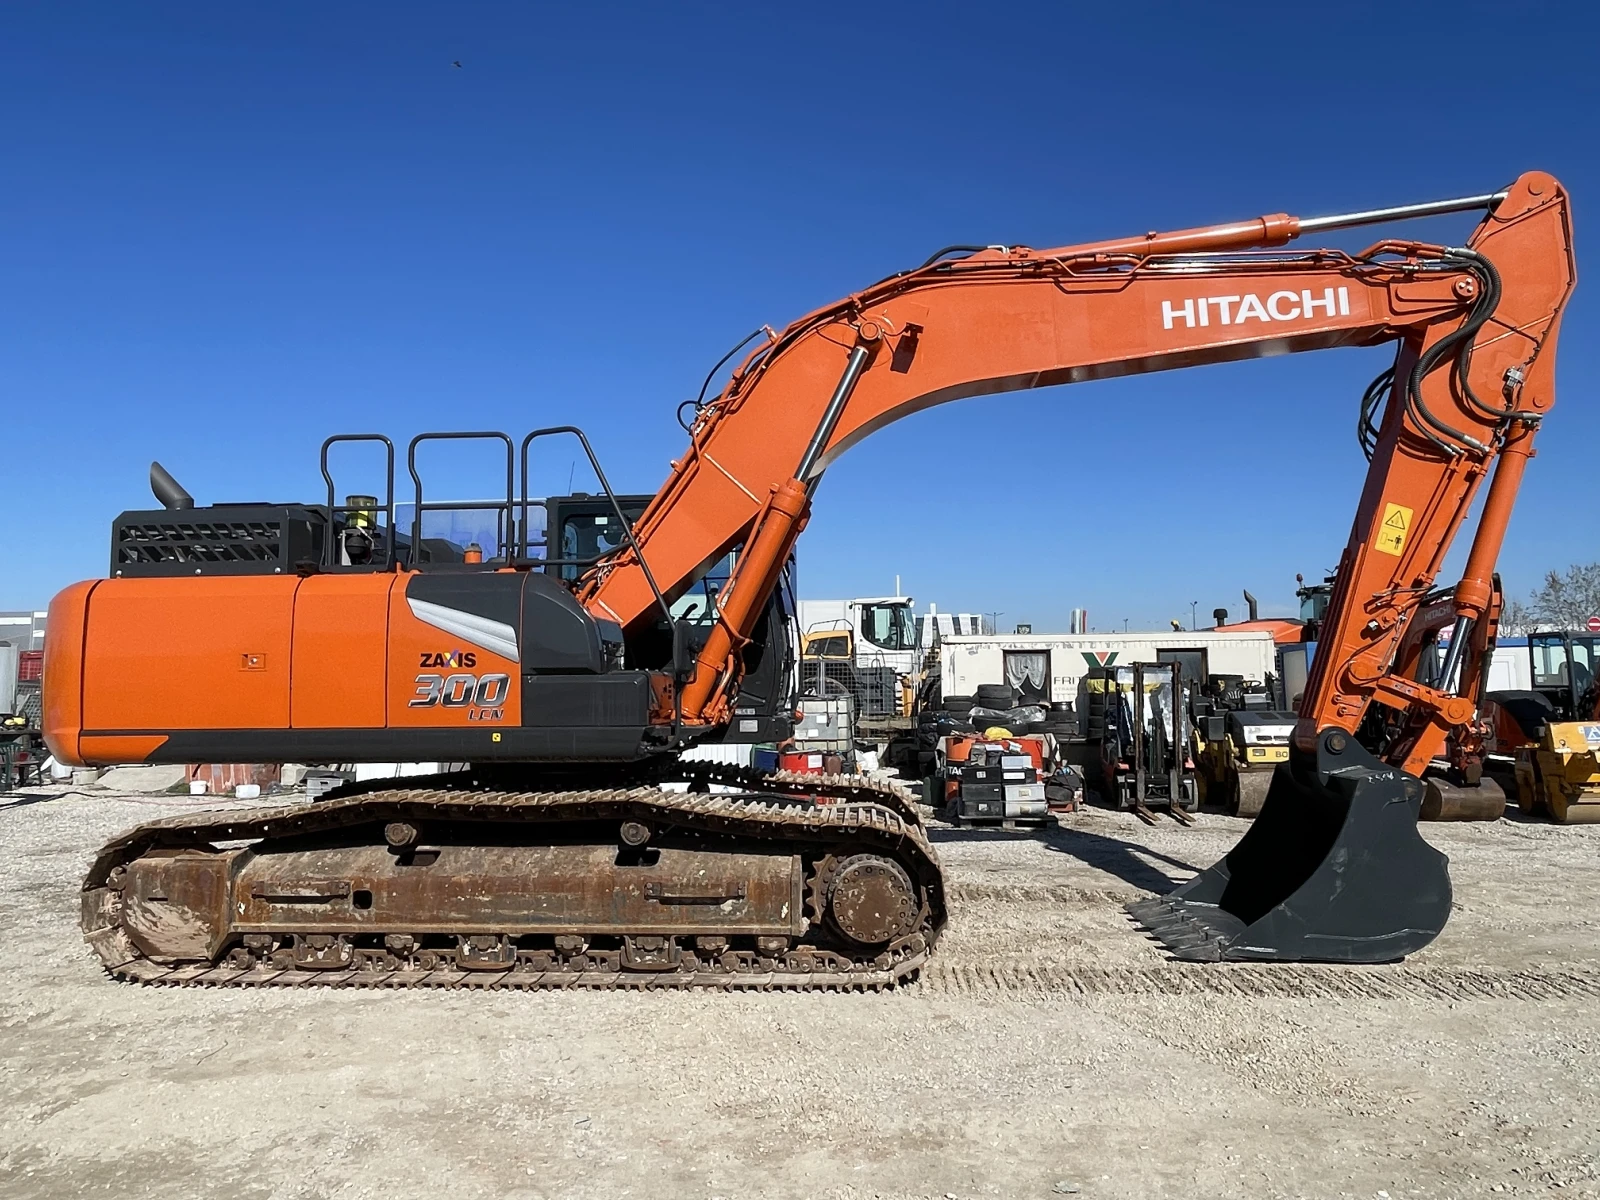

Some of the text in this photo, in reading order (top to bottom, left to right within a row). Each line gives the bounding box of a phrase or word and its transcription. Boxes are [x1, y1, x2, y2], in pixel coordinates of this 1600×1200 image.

[1162, 287, 1350, 330] HITACHI
[1424, 604, 1452, 621] HITACHI
[420, 649, 477, 669] ZAXIS
[408, 673, 511, 708] 300
[468, 708, 505, 721] LCN
